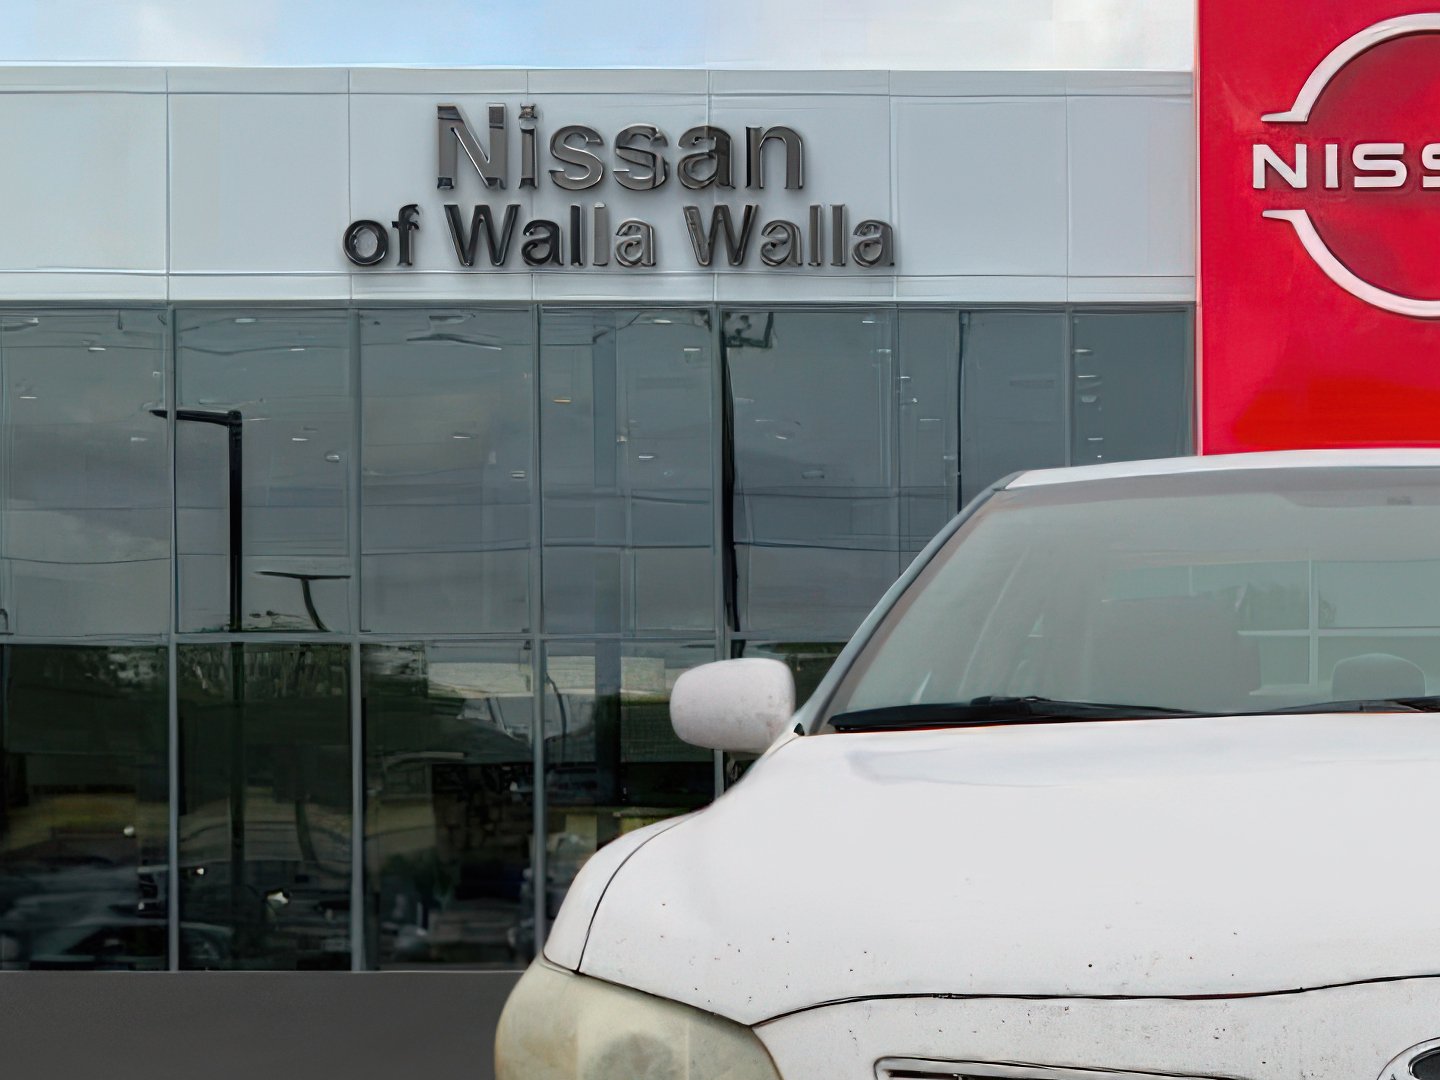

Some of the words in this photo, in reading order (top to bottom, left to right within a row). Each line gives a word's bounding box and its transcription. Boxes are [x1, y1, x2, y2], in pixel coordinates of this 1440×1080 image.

[437, 103, 804, 190] Nissan
[342, 204, 421, 266] of
[444, 204, 656, 266] Walla
[683, 204, 895, 266] Walla
